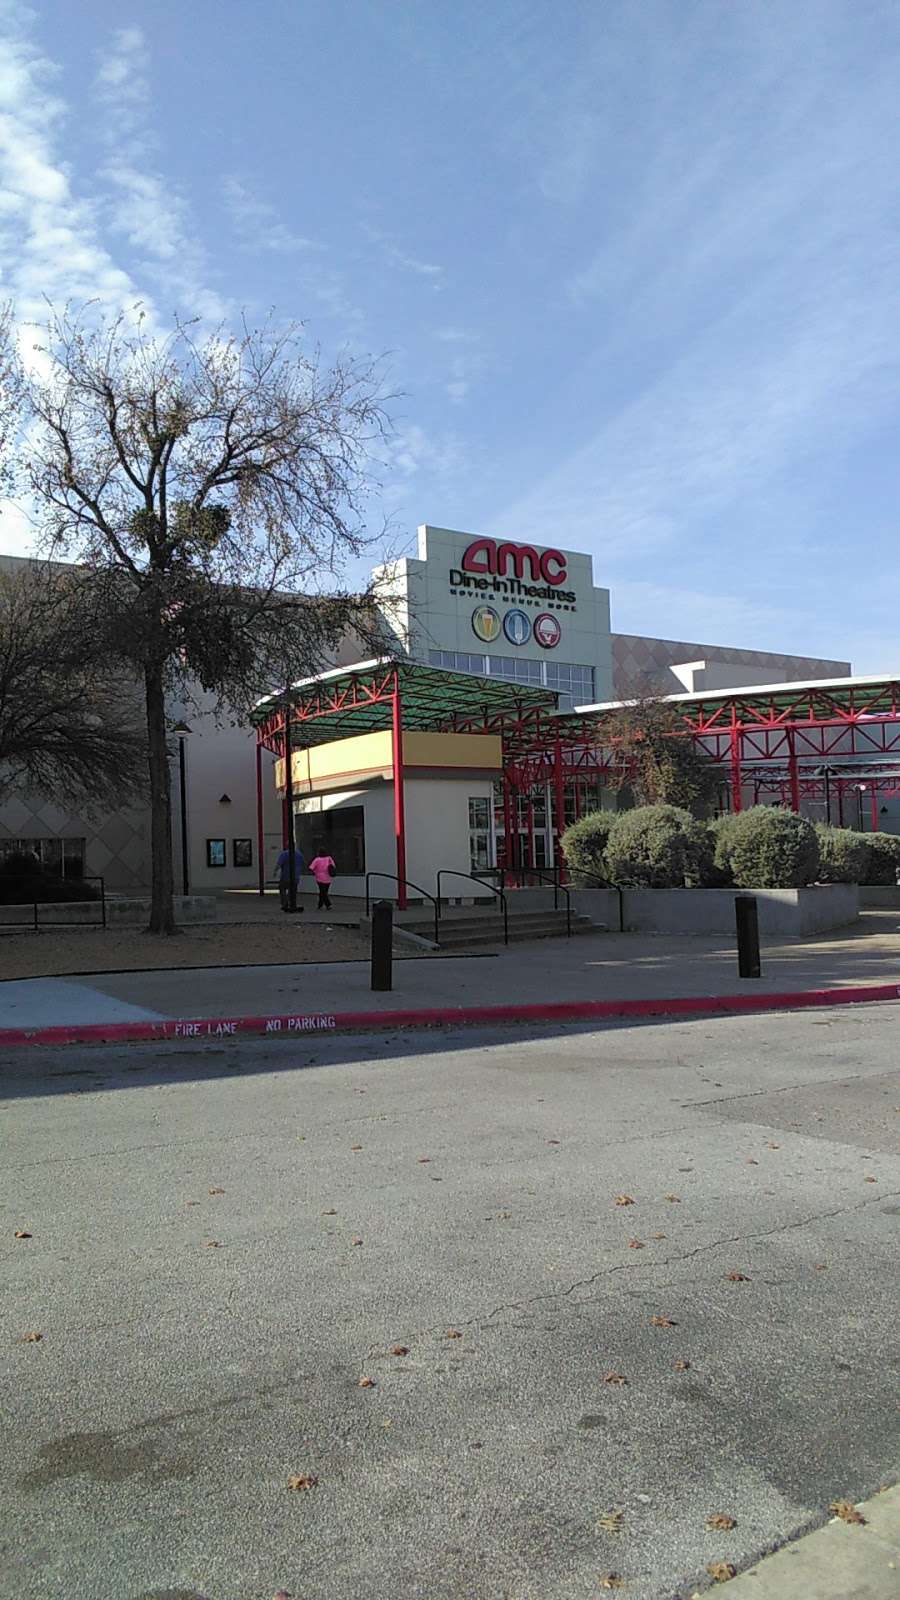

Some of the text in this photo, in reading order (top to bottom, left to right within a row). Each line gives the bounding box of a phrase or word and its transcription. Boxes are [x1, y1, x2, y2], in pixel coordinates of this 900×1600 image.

[175, 1022, 238, 1036] FIRE LANE
[266, 1016, 336, 1032] NO PARKING
